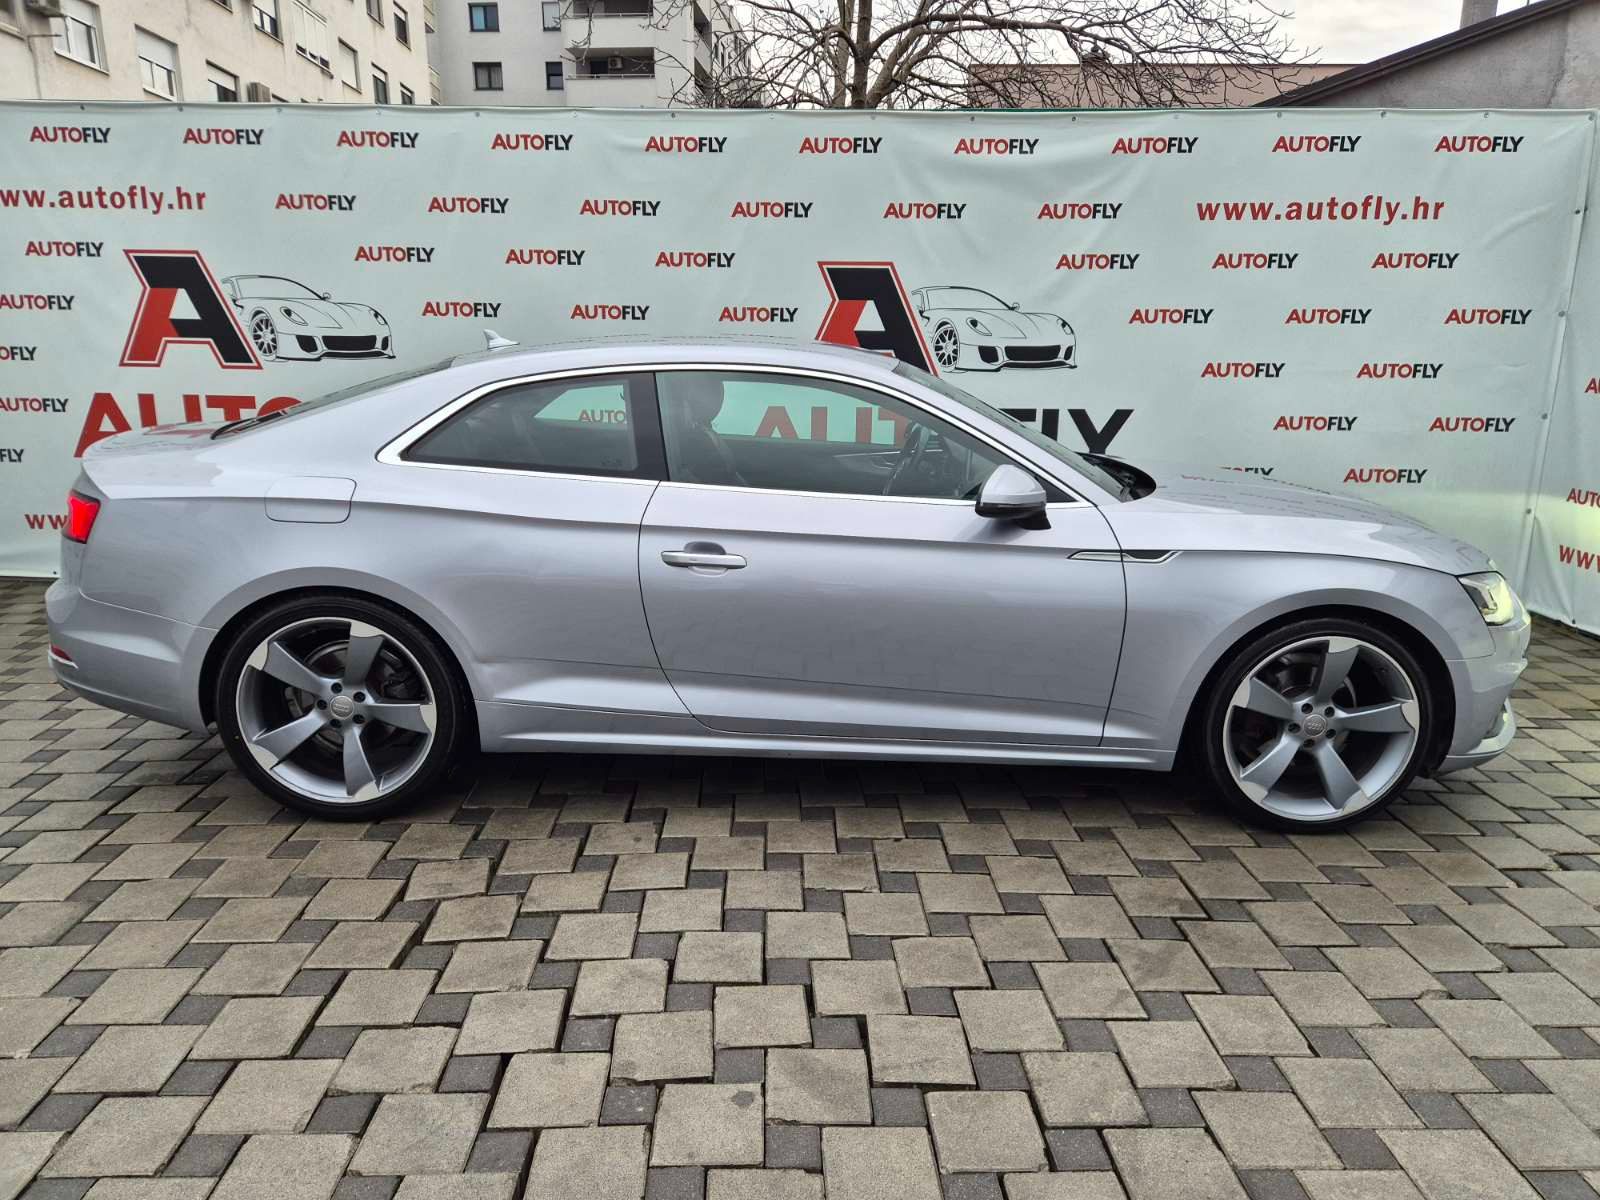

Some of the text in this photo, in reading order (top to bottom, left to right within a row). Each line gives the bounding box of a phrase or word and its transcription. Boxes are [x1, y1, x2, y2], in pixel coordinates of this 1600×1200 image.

[30, 126, 111, 143] AUTOFLY
[183, 128, 264, 145] AUTOFLY
[337, 131, 419, 148] AUTOFLY
[491, 134, 573, 150] AUTOFLY
[645, 136, 727, 152] AUTOFLY
[799, 137, 882, 153] AUTOFLY
[954, 138, 1039, 154] AUTOFLY
[1112, 137, 1198, 154] AUTOFLY
[1272, 135, 1362, 152] AUTOFLY
[1435, 136, 1524, 152] AUTOFLY
[275, 194, 356, 211] AUTOFLY
[428, 197, 509, 214] AUTOFLY
[580, 200, 661, 216] AUTOFLY
[731, 202, 813, 218] AUTOFLY
[1197, 195, 1444, 225] www.autofly.hr
[883, 203, 966, 219] AUTOFLY
[1038, 203, 1123, 219] AUTOFLY
[25, 241, 104, 257] AUTOFLY
[354, 246, 435, 263] AUTOFLY
[505, 249, 585, 265] AUTOFLY
[655, 252, 735, 268] AUTOFLY
[1056, 254, 1140, 270] AUTOFLY
[1212, 253, 1299, 269] AUTOFLY
[1371, 253, 1459, 269] AUTOFLY
[0, 294, 75, 310] AUTOFLY
[422, 302, 501, 318] AUTOFLY
[571, 304, 649, 320] AUTOFLY
[719, 306, 798, 322] AUTOFLY
[1129, 309, 1214, 324] AUTOFLY
[1285, 309, 1372, 324] AUTOFLY
[1444, 309, 1532, 324] AUTOFLY
[1201, 363, 1285, 378] AUTOFLY
[1356, 363, 1443, 379] AUTOFLY
[1273, 416, 1358, 431] AUTOFLY
[1429, 417, 1515, 432] AUTOFLY
[1343, 469, 1427, 484] AUTOFLY
